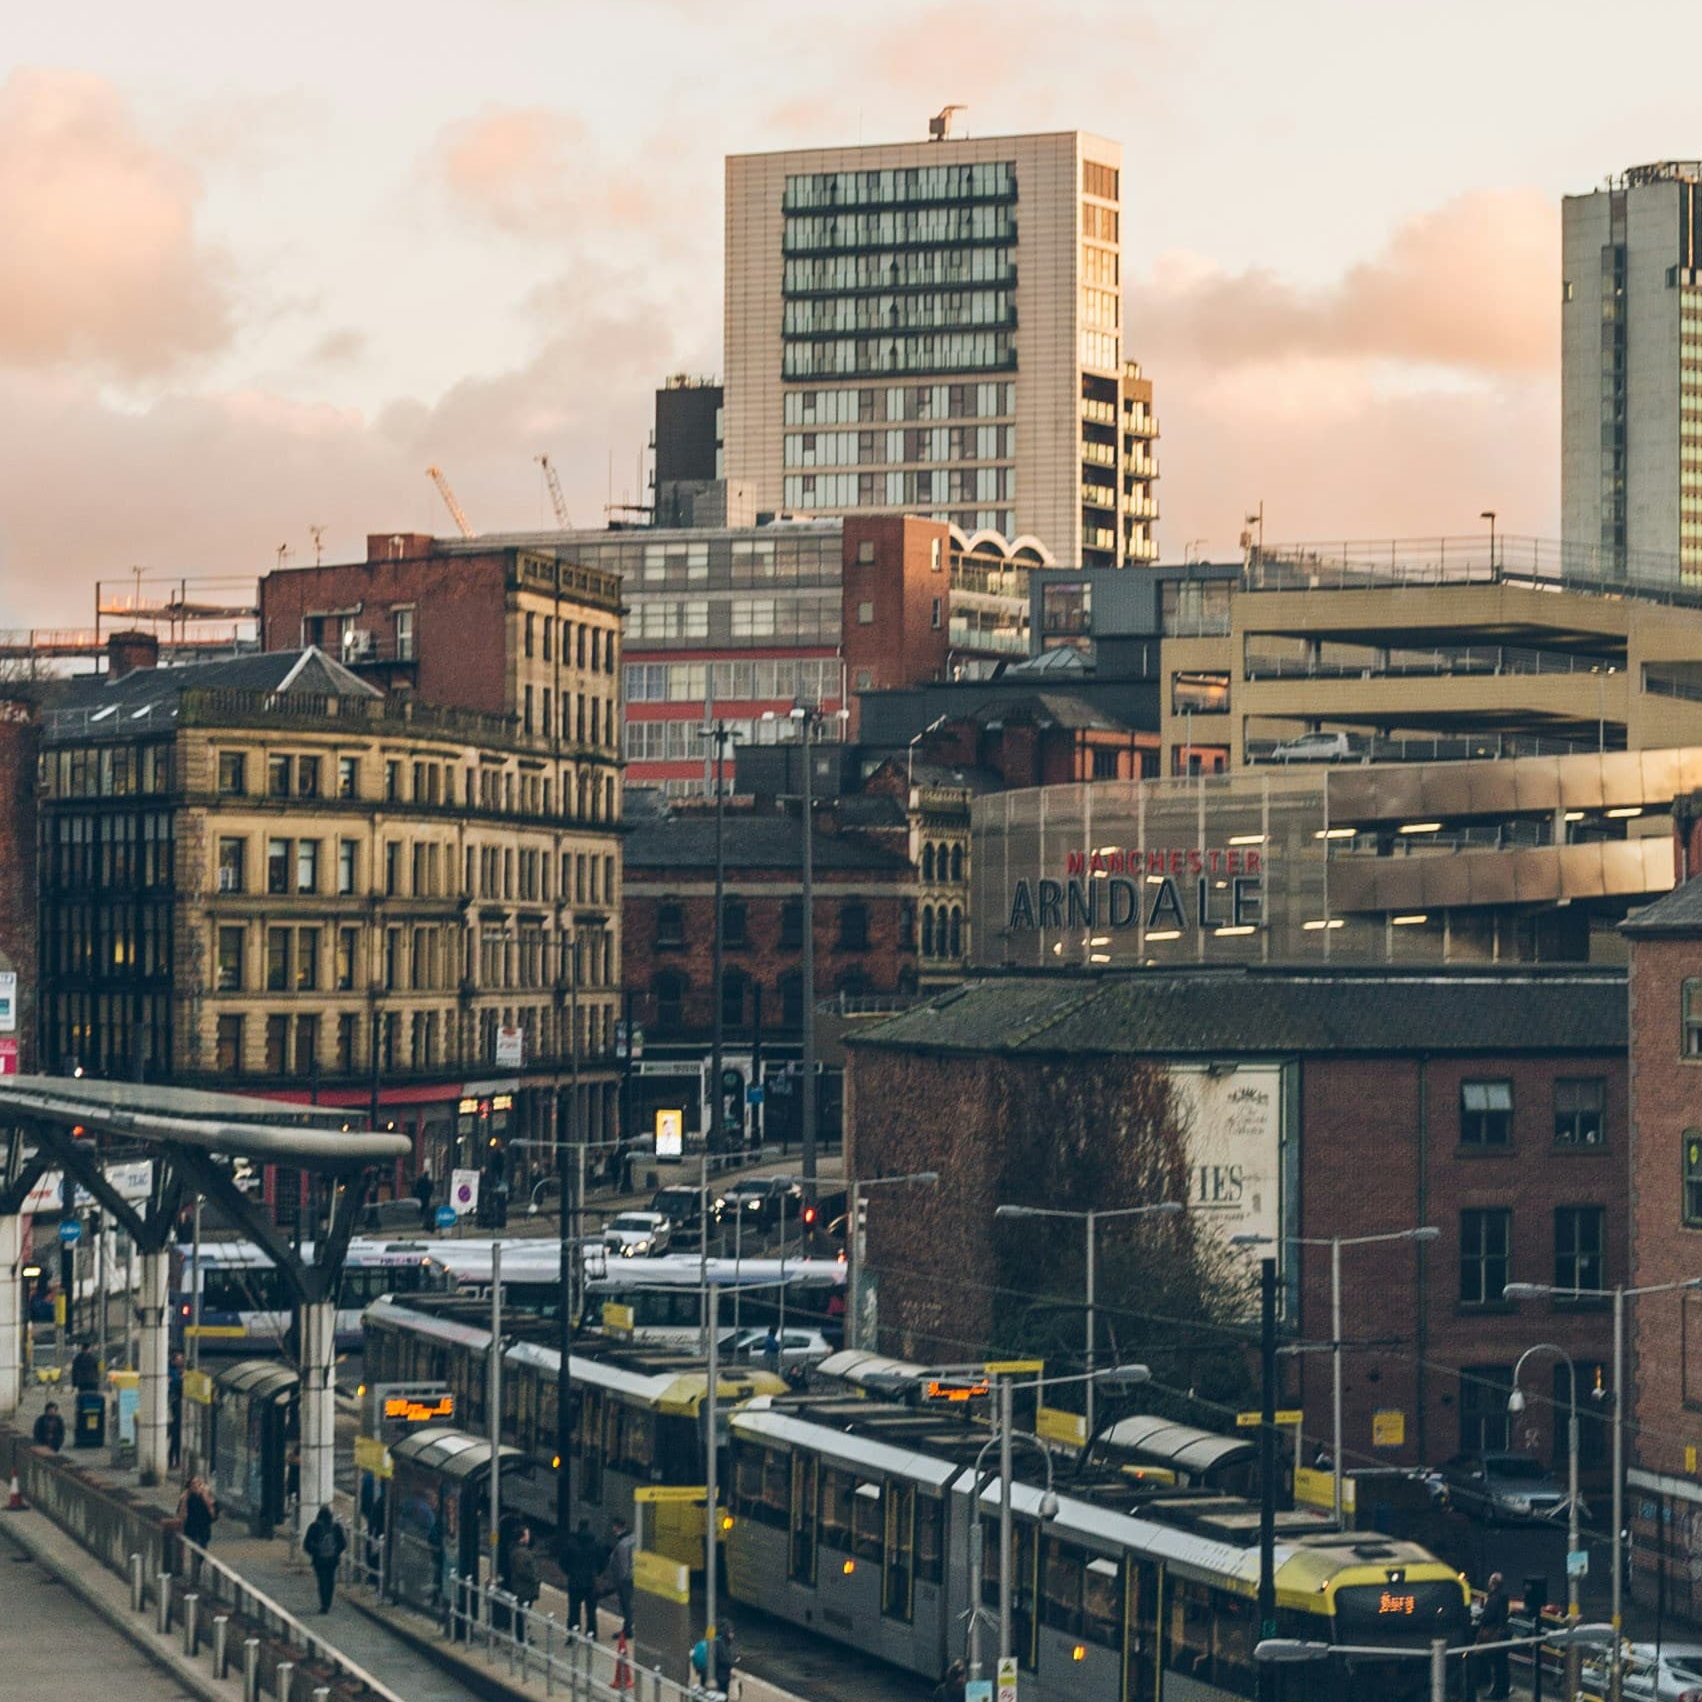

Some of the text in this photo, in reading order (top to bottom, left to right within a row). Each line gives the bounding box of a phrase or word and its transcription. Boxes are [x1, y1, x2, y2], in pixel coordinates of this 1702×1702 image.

[1066, 847, 1264, 875] MANCHESTER
[1008, 873, 1266, 930] ARNDALE
[1198, 1164, 1243, 1203] IES
